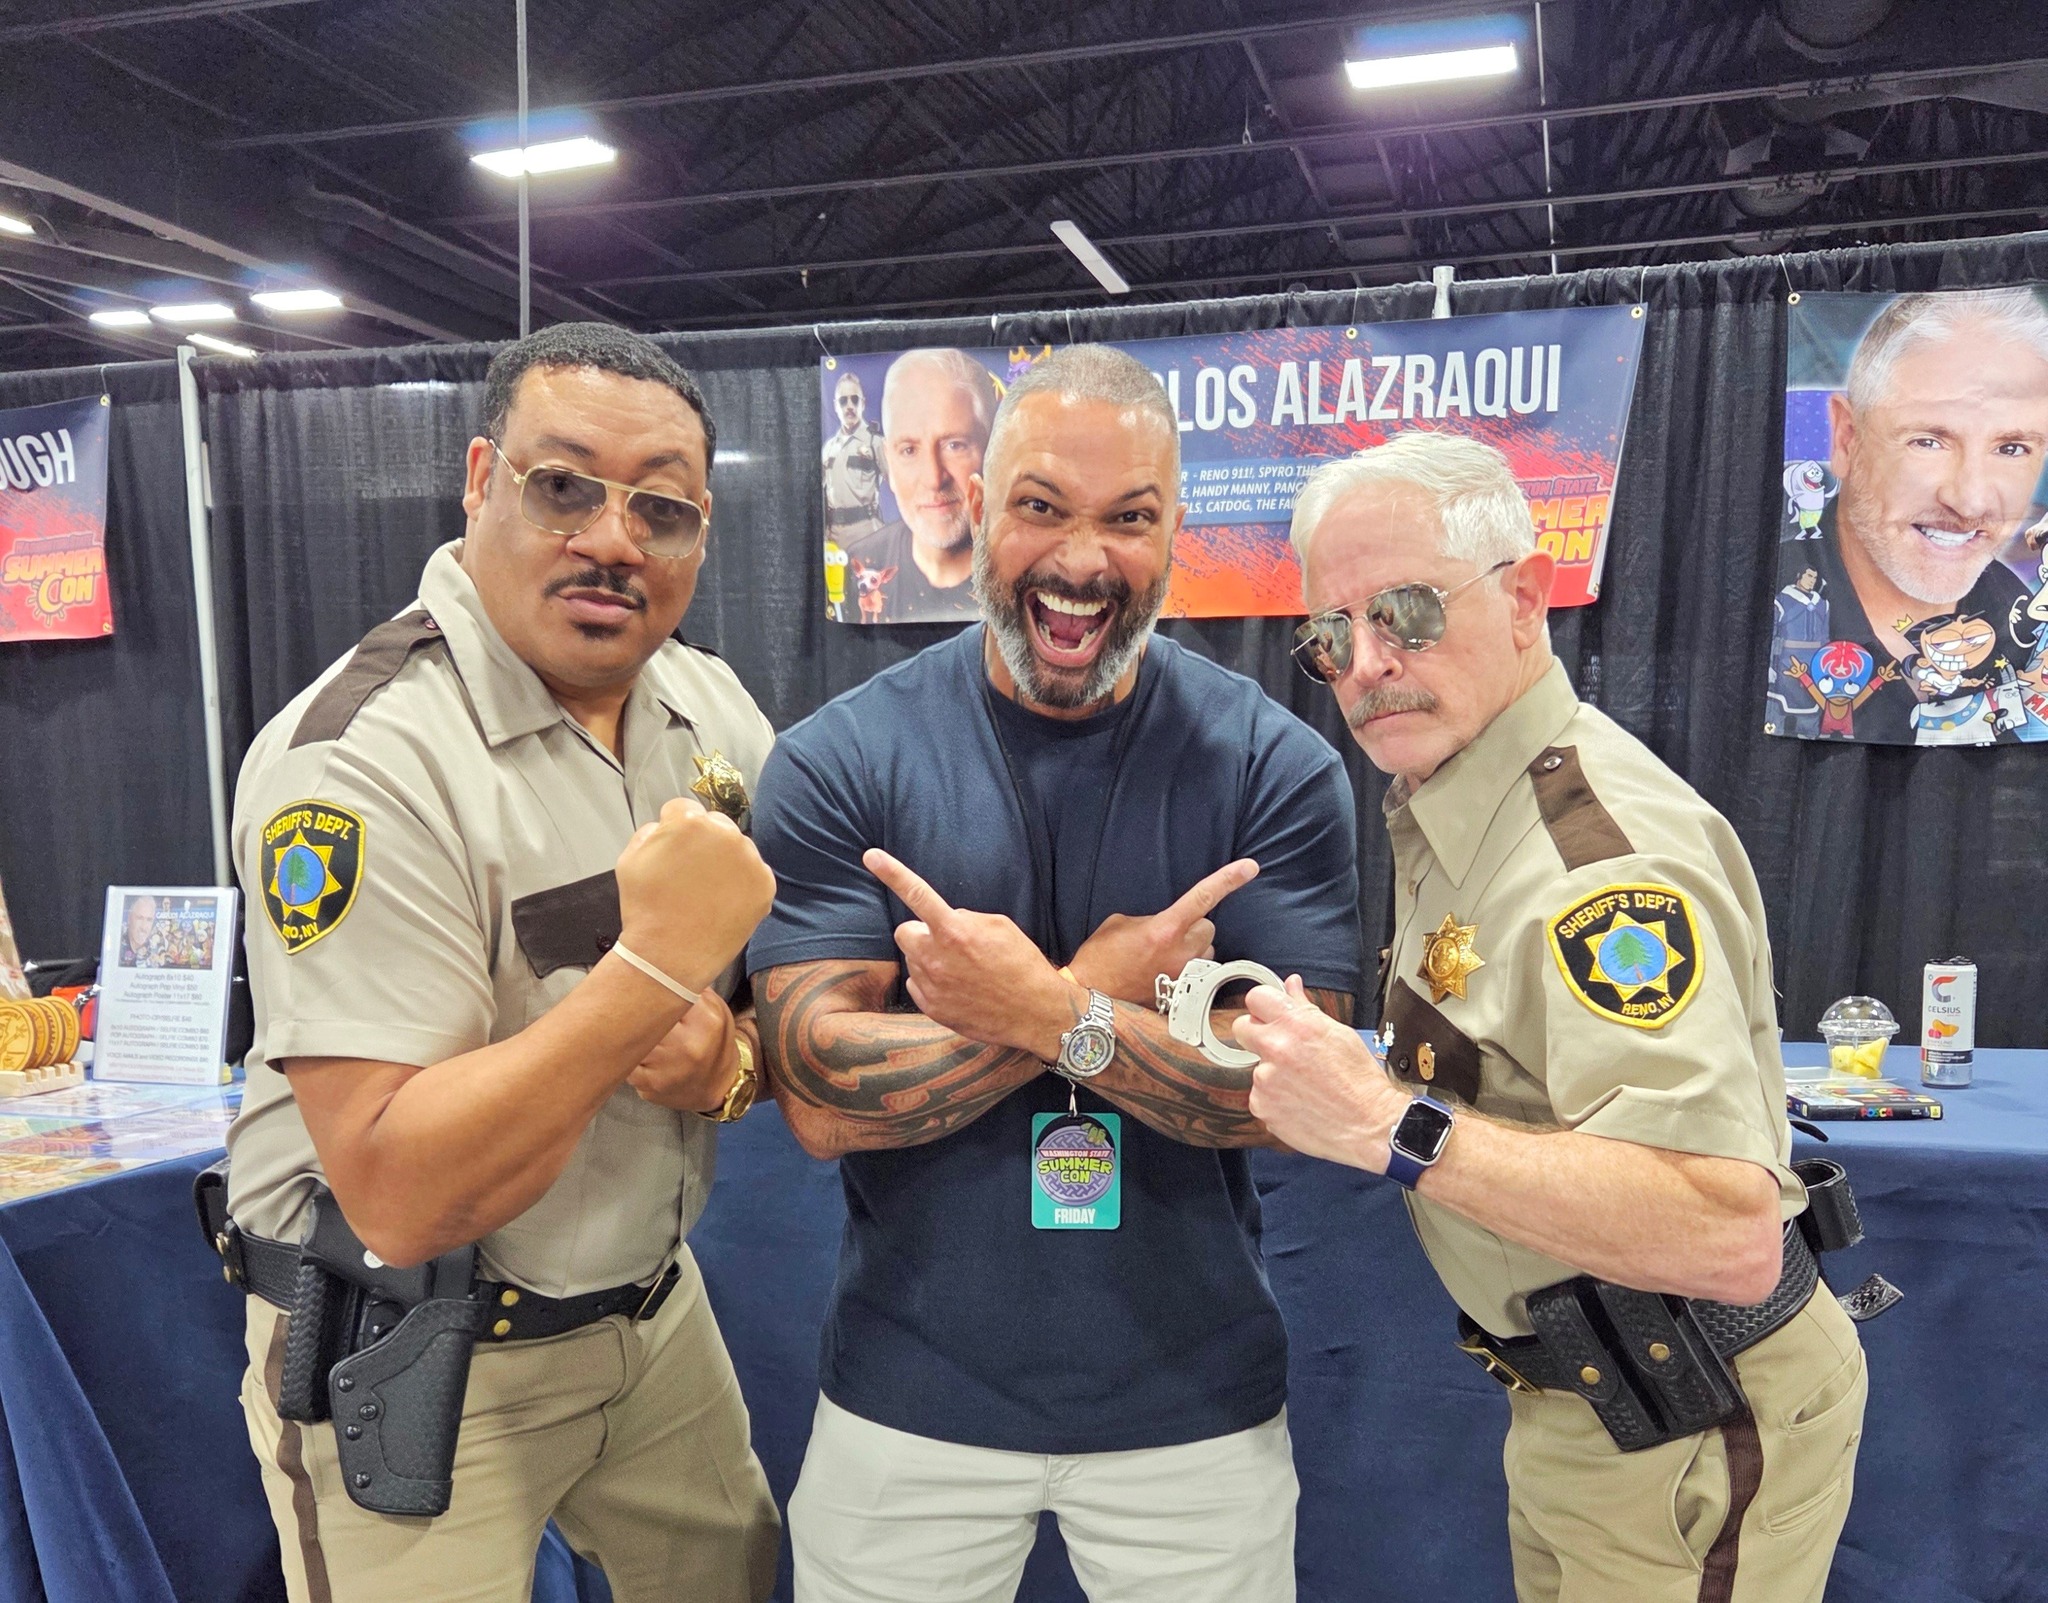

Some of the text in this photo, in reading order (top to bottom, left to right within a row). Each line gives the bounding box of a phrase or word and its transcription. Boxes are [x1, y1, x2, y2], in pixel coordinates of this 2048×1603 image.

[1152, 343, 1562, 432] LOS ALAZRAQUI
[0, 428, 76, 490] UGH
[1200, 469, 1229, 482] RENO
[1258, 465, 1294, 478] SPYRO
[1192, 484, 1229, 498] HANDY
[1230, 482, 1272, 496] MANNY,
[1206, 498, 1253, 513] CATDOG,
[1256, 497, 1277, 510] THE
[266, 810, 353, 845] SHERIFF'S DEPT.
[1559, 892, 1677, 939] SHERIFF'S DEPT.
[1621, 993, 1675, 1015] RENO, NV
[1928, 1005, 1961, 1014] CELSIUS
[1860, 1107, 1893, 1118] POSCA
[1038, 1158, 1114, 1175] SUMMER
[1060, 1170, 1090, 1184] CON
[1054, 1208, 1096, 1225] FRIDAY
